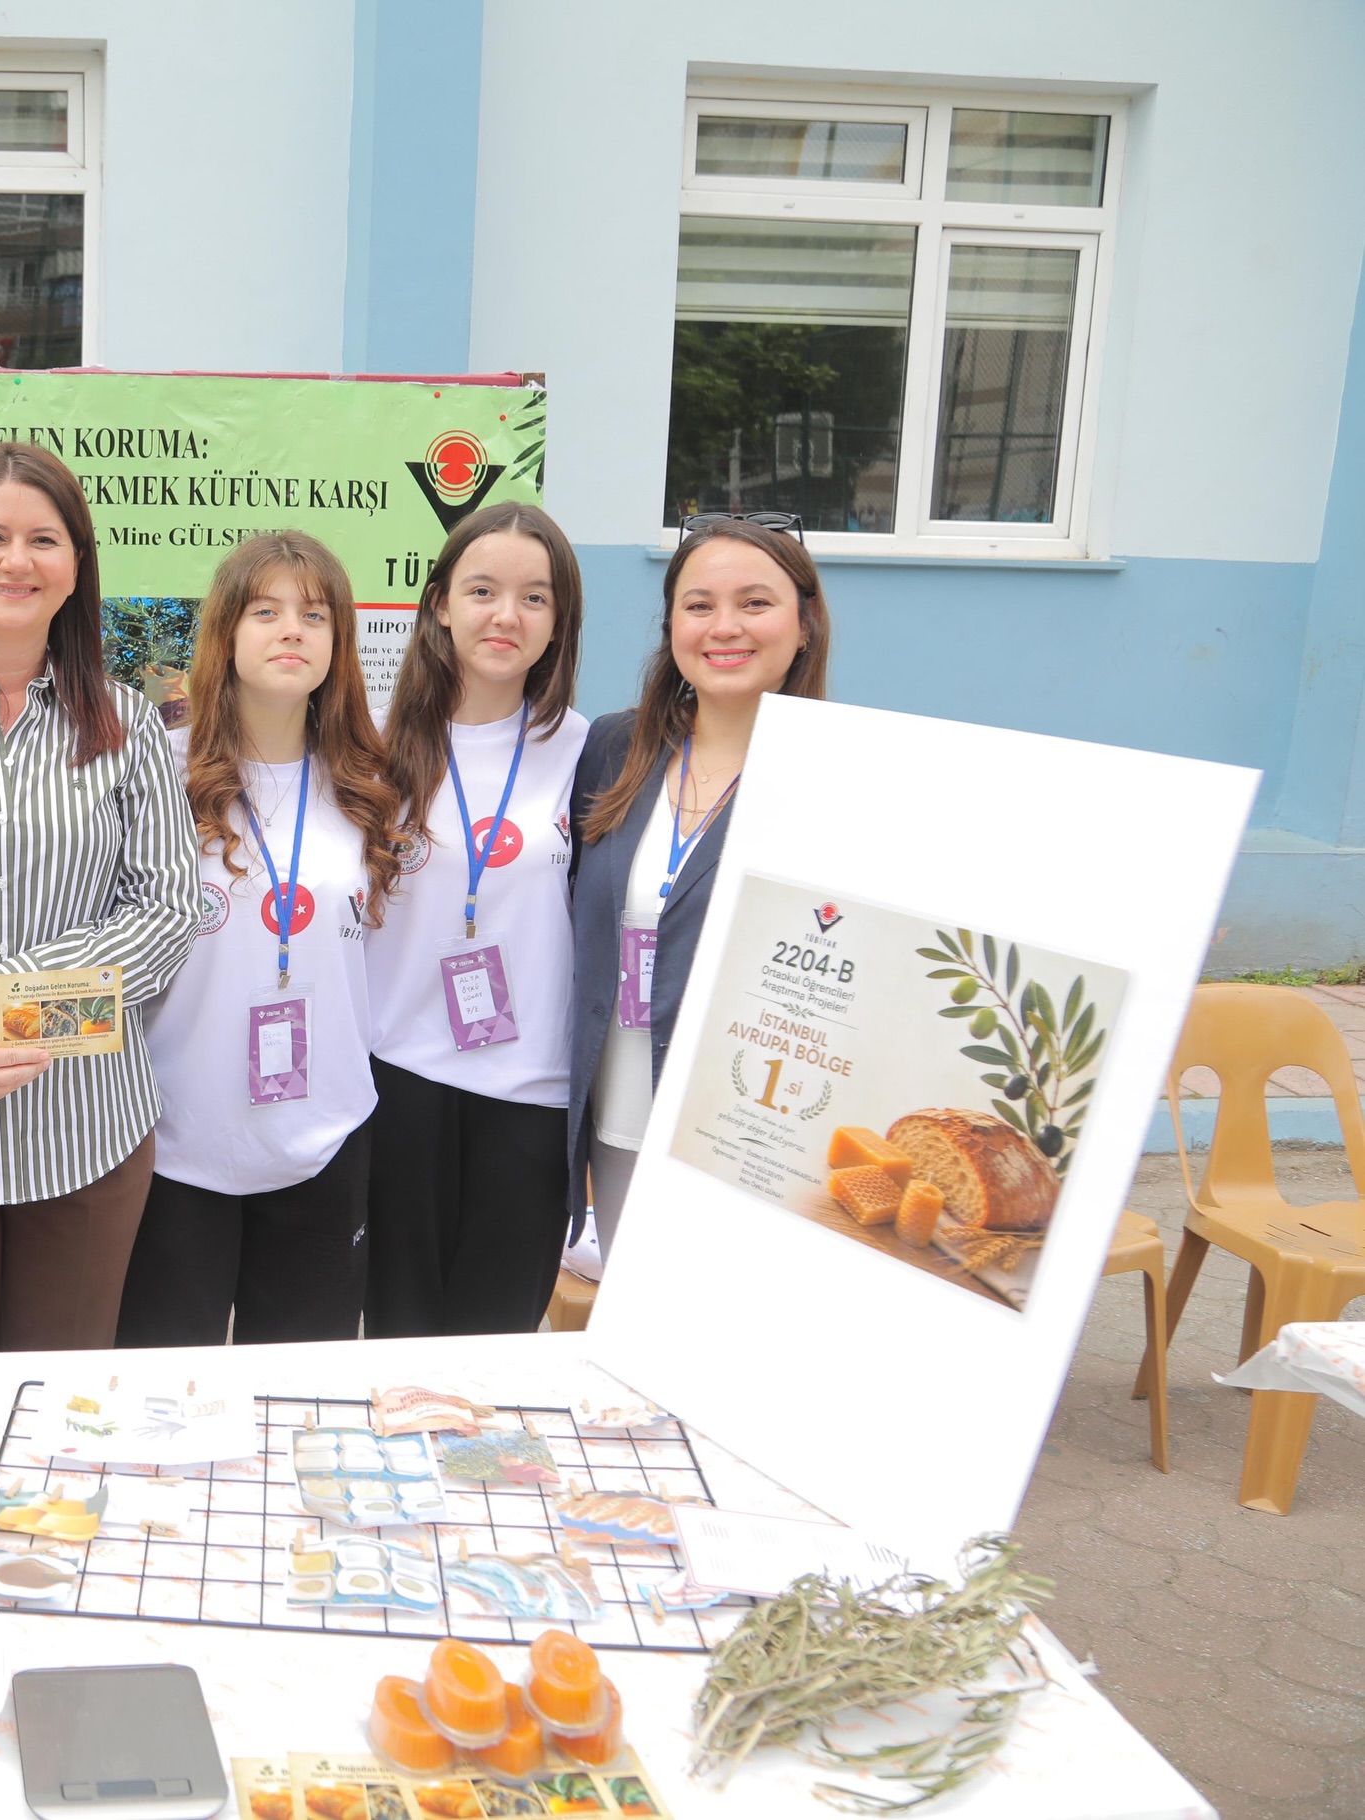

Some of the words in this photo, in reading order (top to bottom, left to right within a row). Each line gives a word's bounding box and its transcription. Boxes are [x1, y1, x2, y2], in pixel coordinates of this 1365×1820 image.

[75, 427, 208, 460] KORUMA:
[80, 474, 180, 506] EKMEK
[188, 469, 300, 508] KÜFÜNE
[308, 478, 389, 517] KARŞI
[108, 526, 162, 546] Mine
[381, 647, 393, 655] ve
[804, 933, 838, 949] TÜBİTAK
[772, 941, 855, 983] 2204-B
[50, 983, 67, 991] Gelen
[761, 979, 805, 1000] Araştırma
[807, 993, 849, 1014] Projeleri
[762, 965, 801, 985] Ortaokul
[802, 976, 855, 1001] Öğrencileri
[759, 1008, 828, 1047] İSTANBUL
[727, 1021, 790, 1056] AVRUPA
[794, 1044, 854, 1077] BÖLGE
